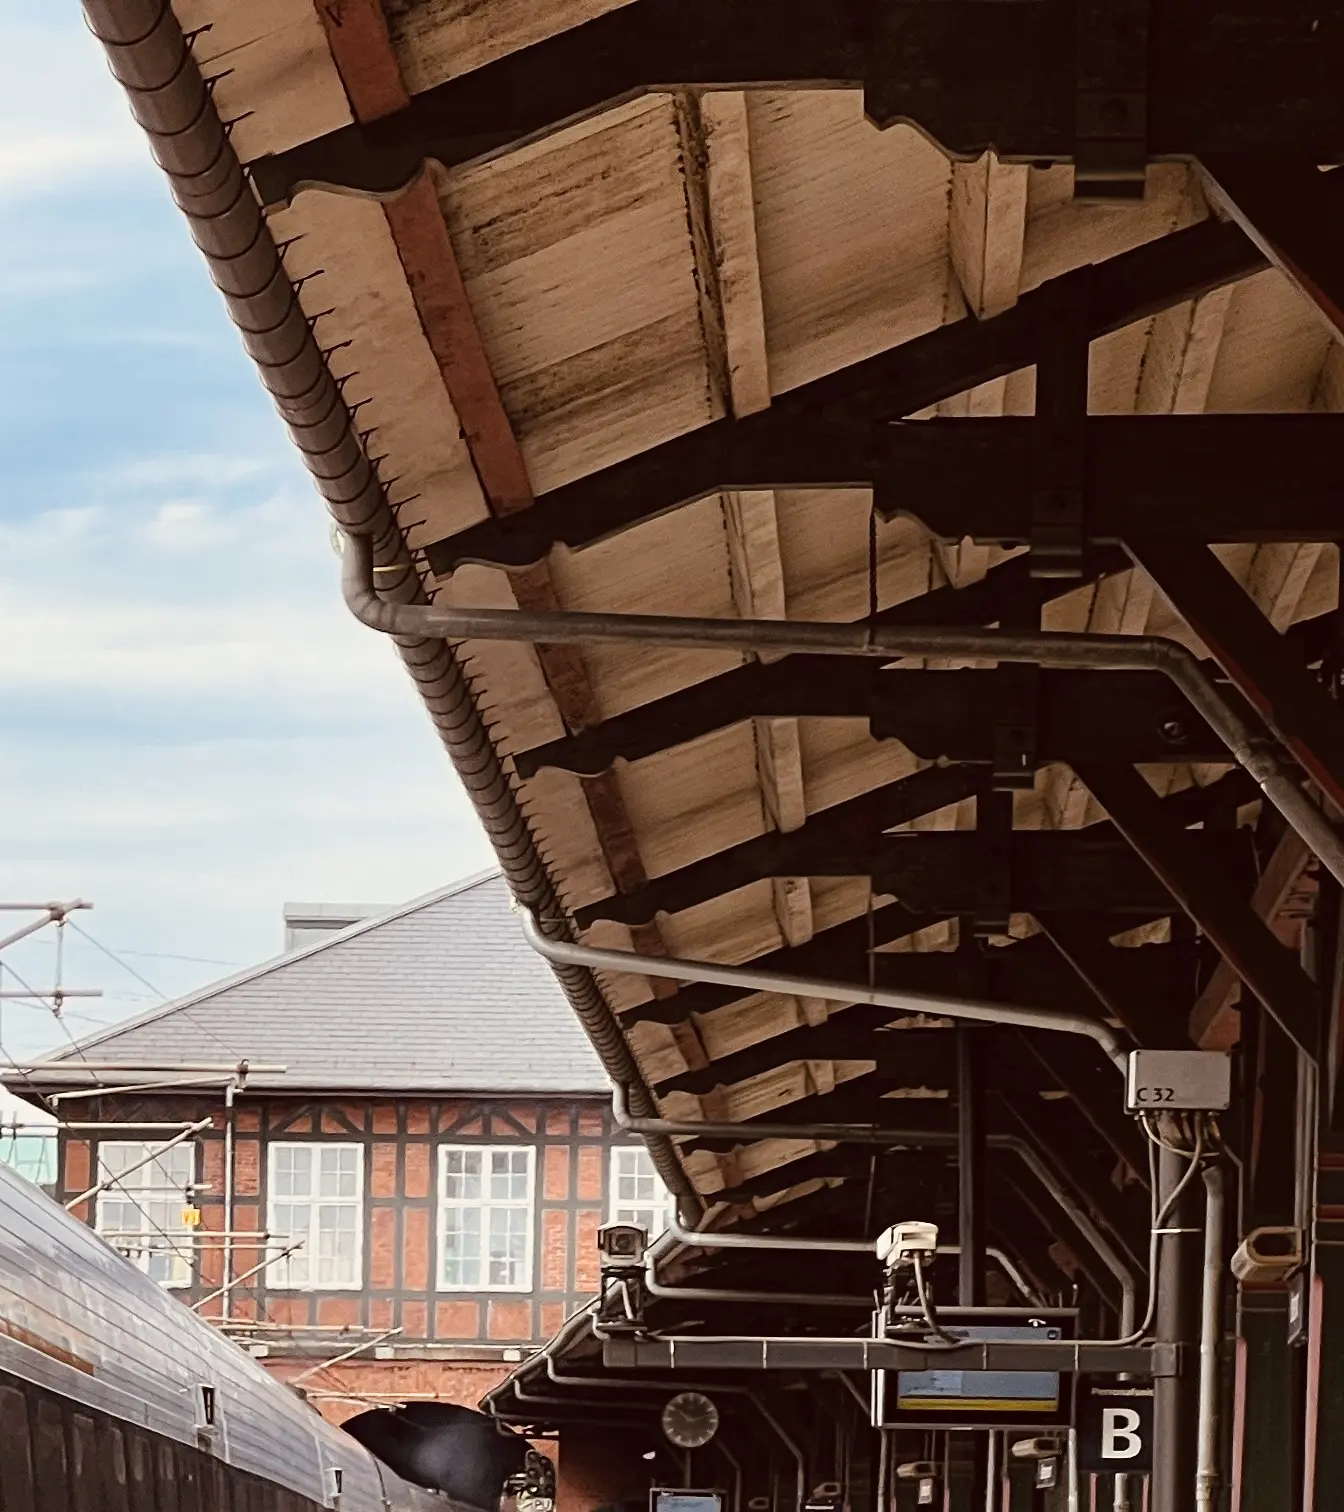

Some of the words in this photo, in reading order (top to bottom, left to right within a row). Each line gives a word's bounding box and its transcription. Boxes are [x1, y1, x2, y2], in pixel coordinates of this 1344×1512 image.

[1136, 1087, 1148, 1102] C
[1152, 1087, 1175, 1102] 32
[1101, 1408, 1142, 1459] B
